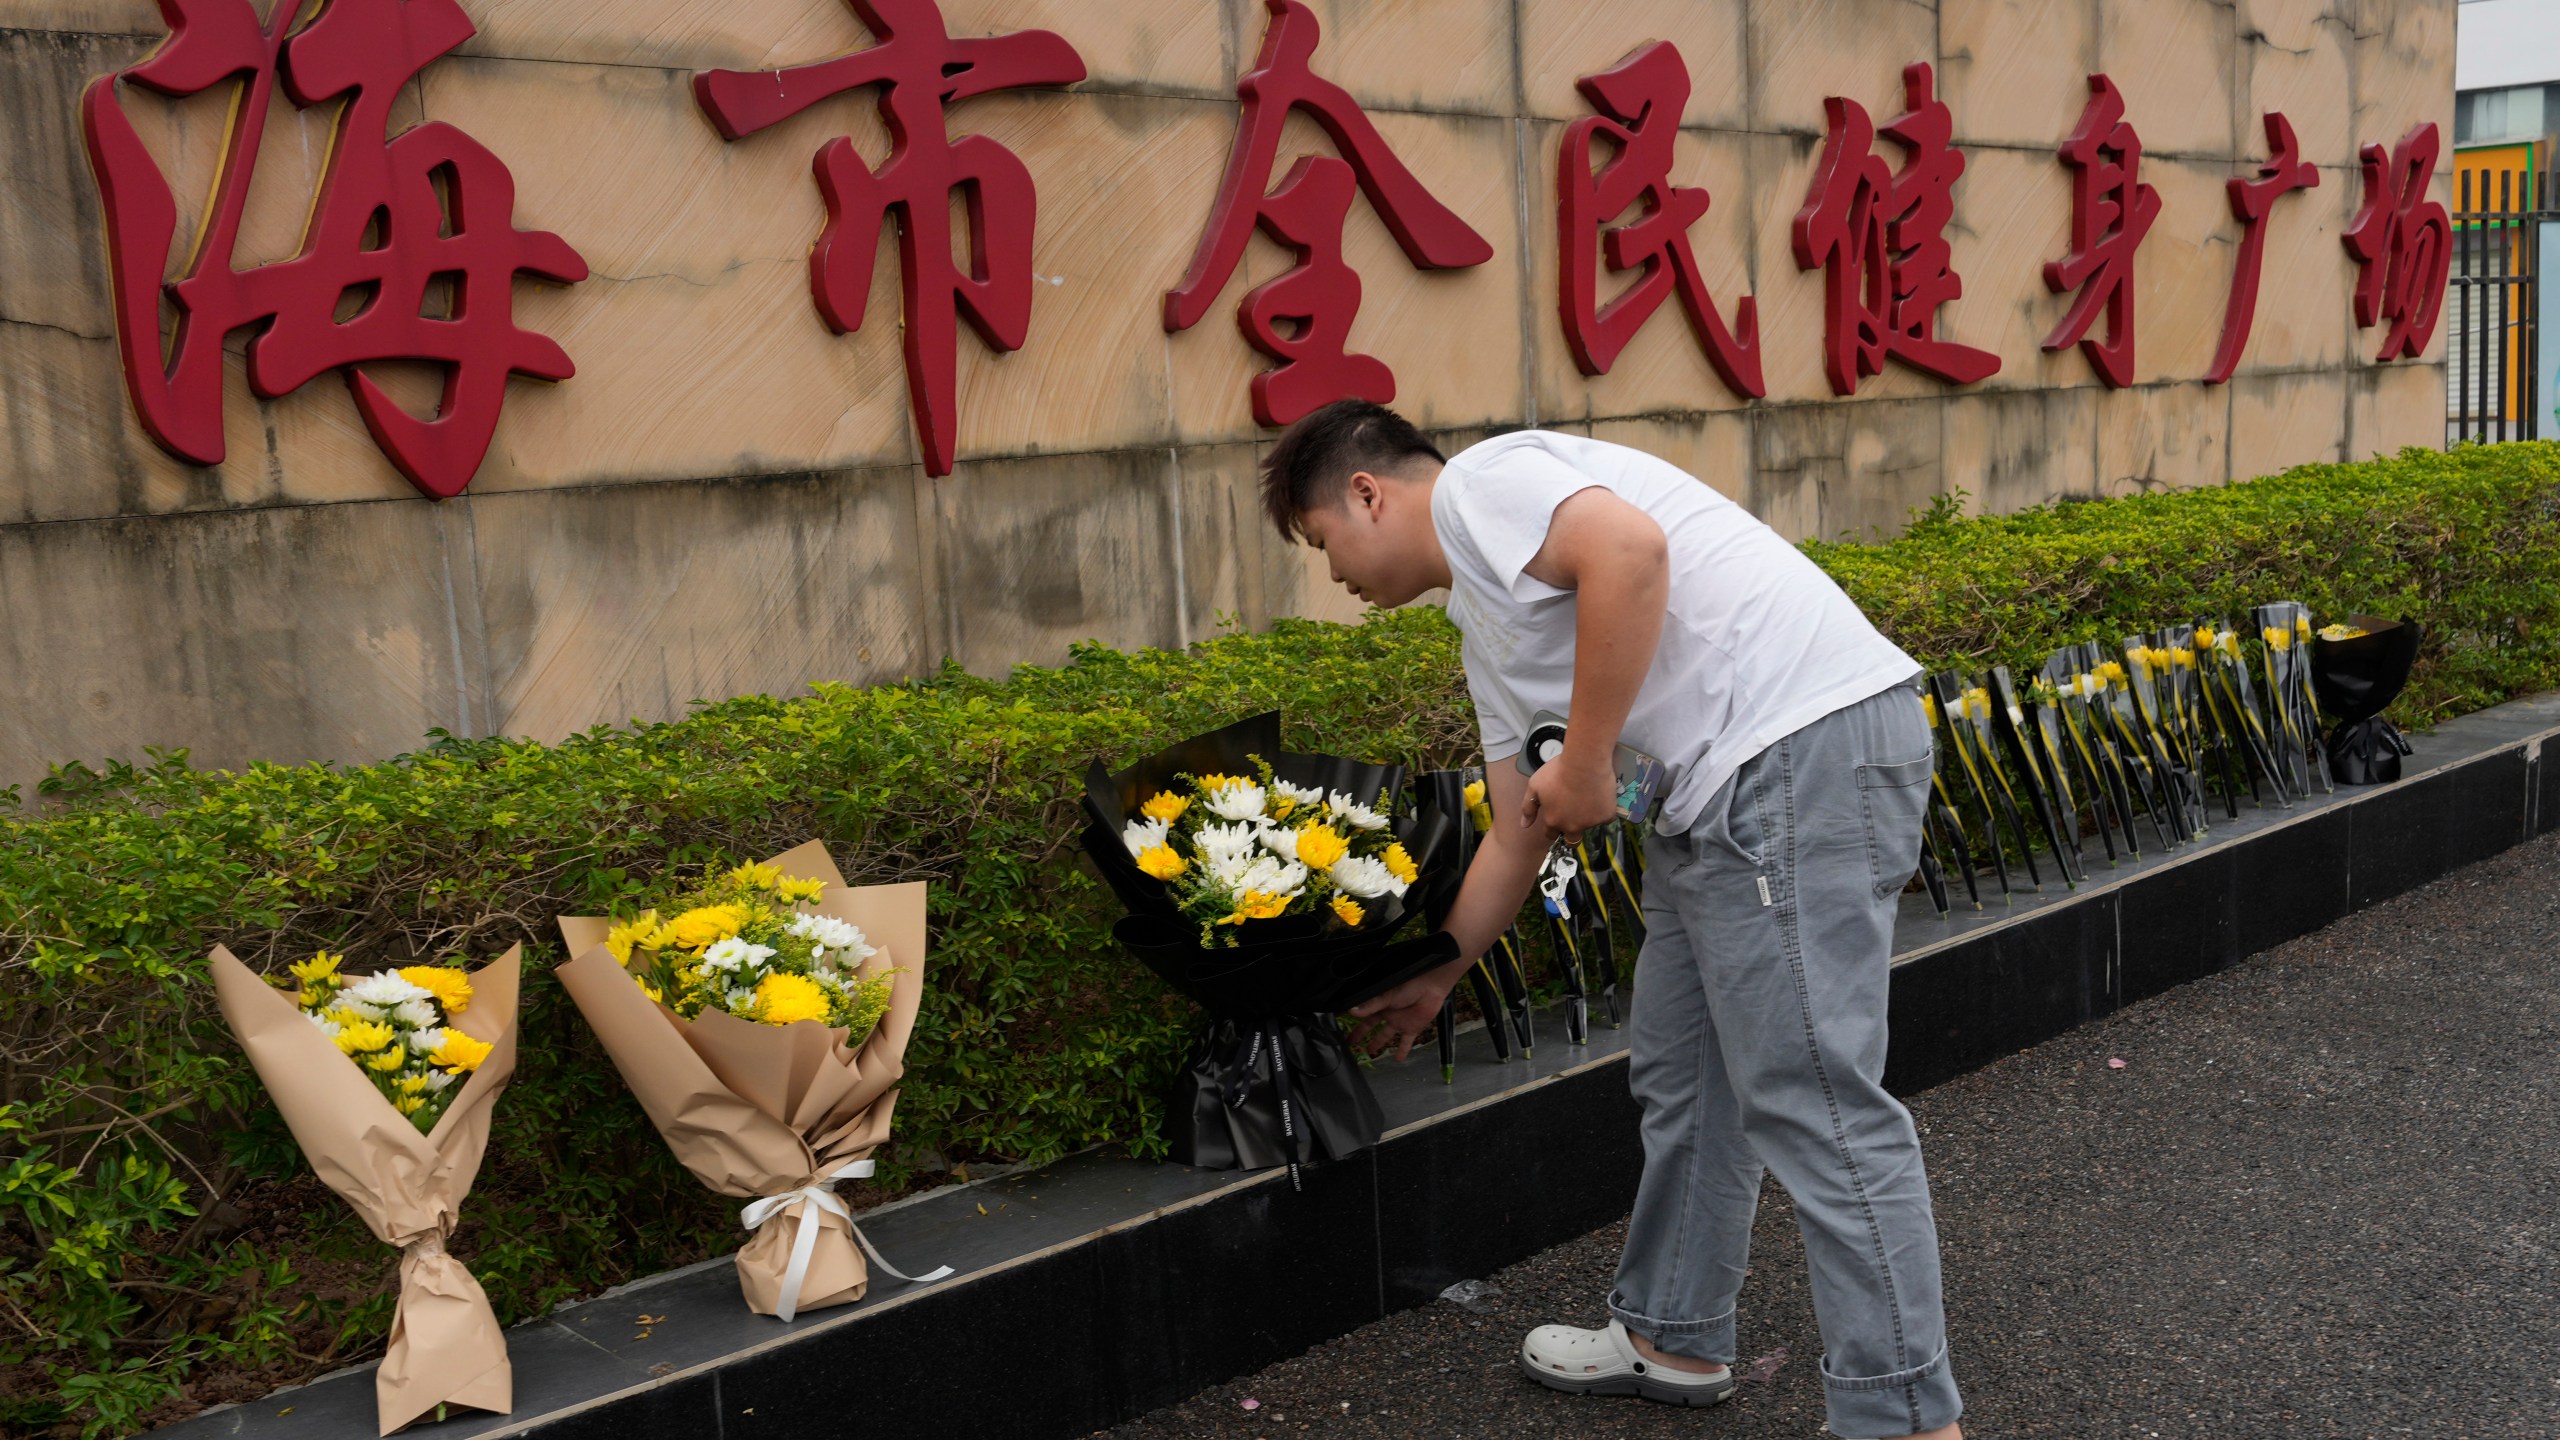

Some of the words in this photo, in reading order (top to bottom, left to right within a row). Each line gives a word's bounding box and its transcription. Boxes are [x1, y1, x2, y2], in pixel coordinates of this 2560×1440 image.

[1248, 1031, 1262, 1067] SWEETLOVE
[1271, 1035, 1284, 1072] SWEETLOVE
[1282, 1100, 1293, 1137] SWEETLOVE
